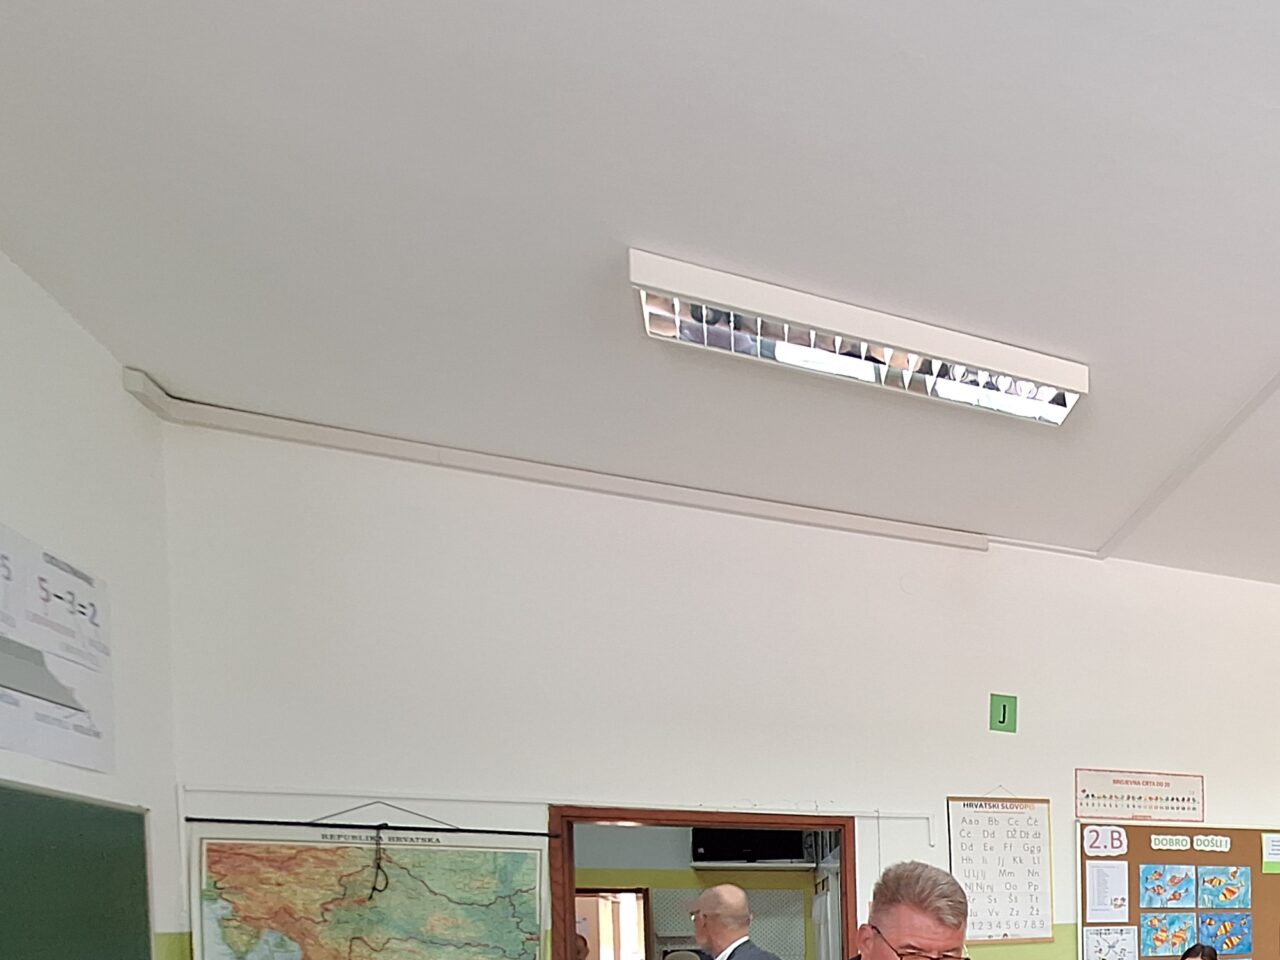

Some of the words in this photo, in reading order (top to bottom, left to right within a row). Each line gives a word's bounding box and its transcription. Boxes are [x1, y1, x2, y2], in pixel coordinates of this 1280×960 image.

[998, 704, 1007, 724] J
[1088, 829, 1124, 849] 2.B
[1153, 837, 1188, 848] DOBRO
